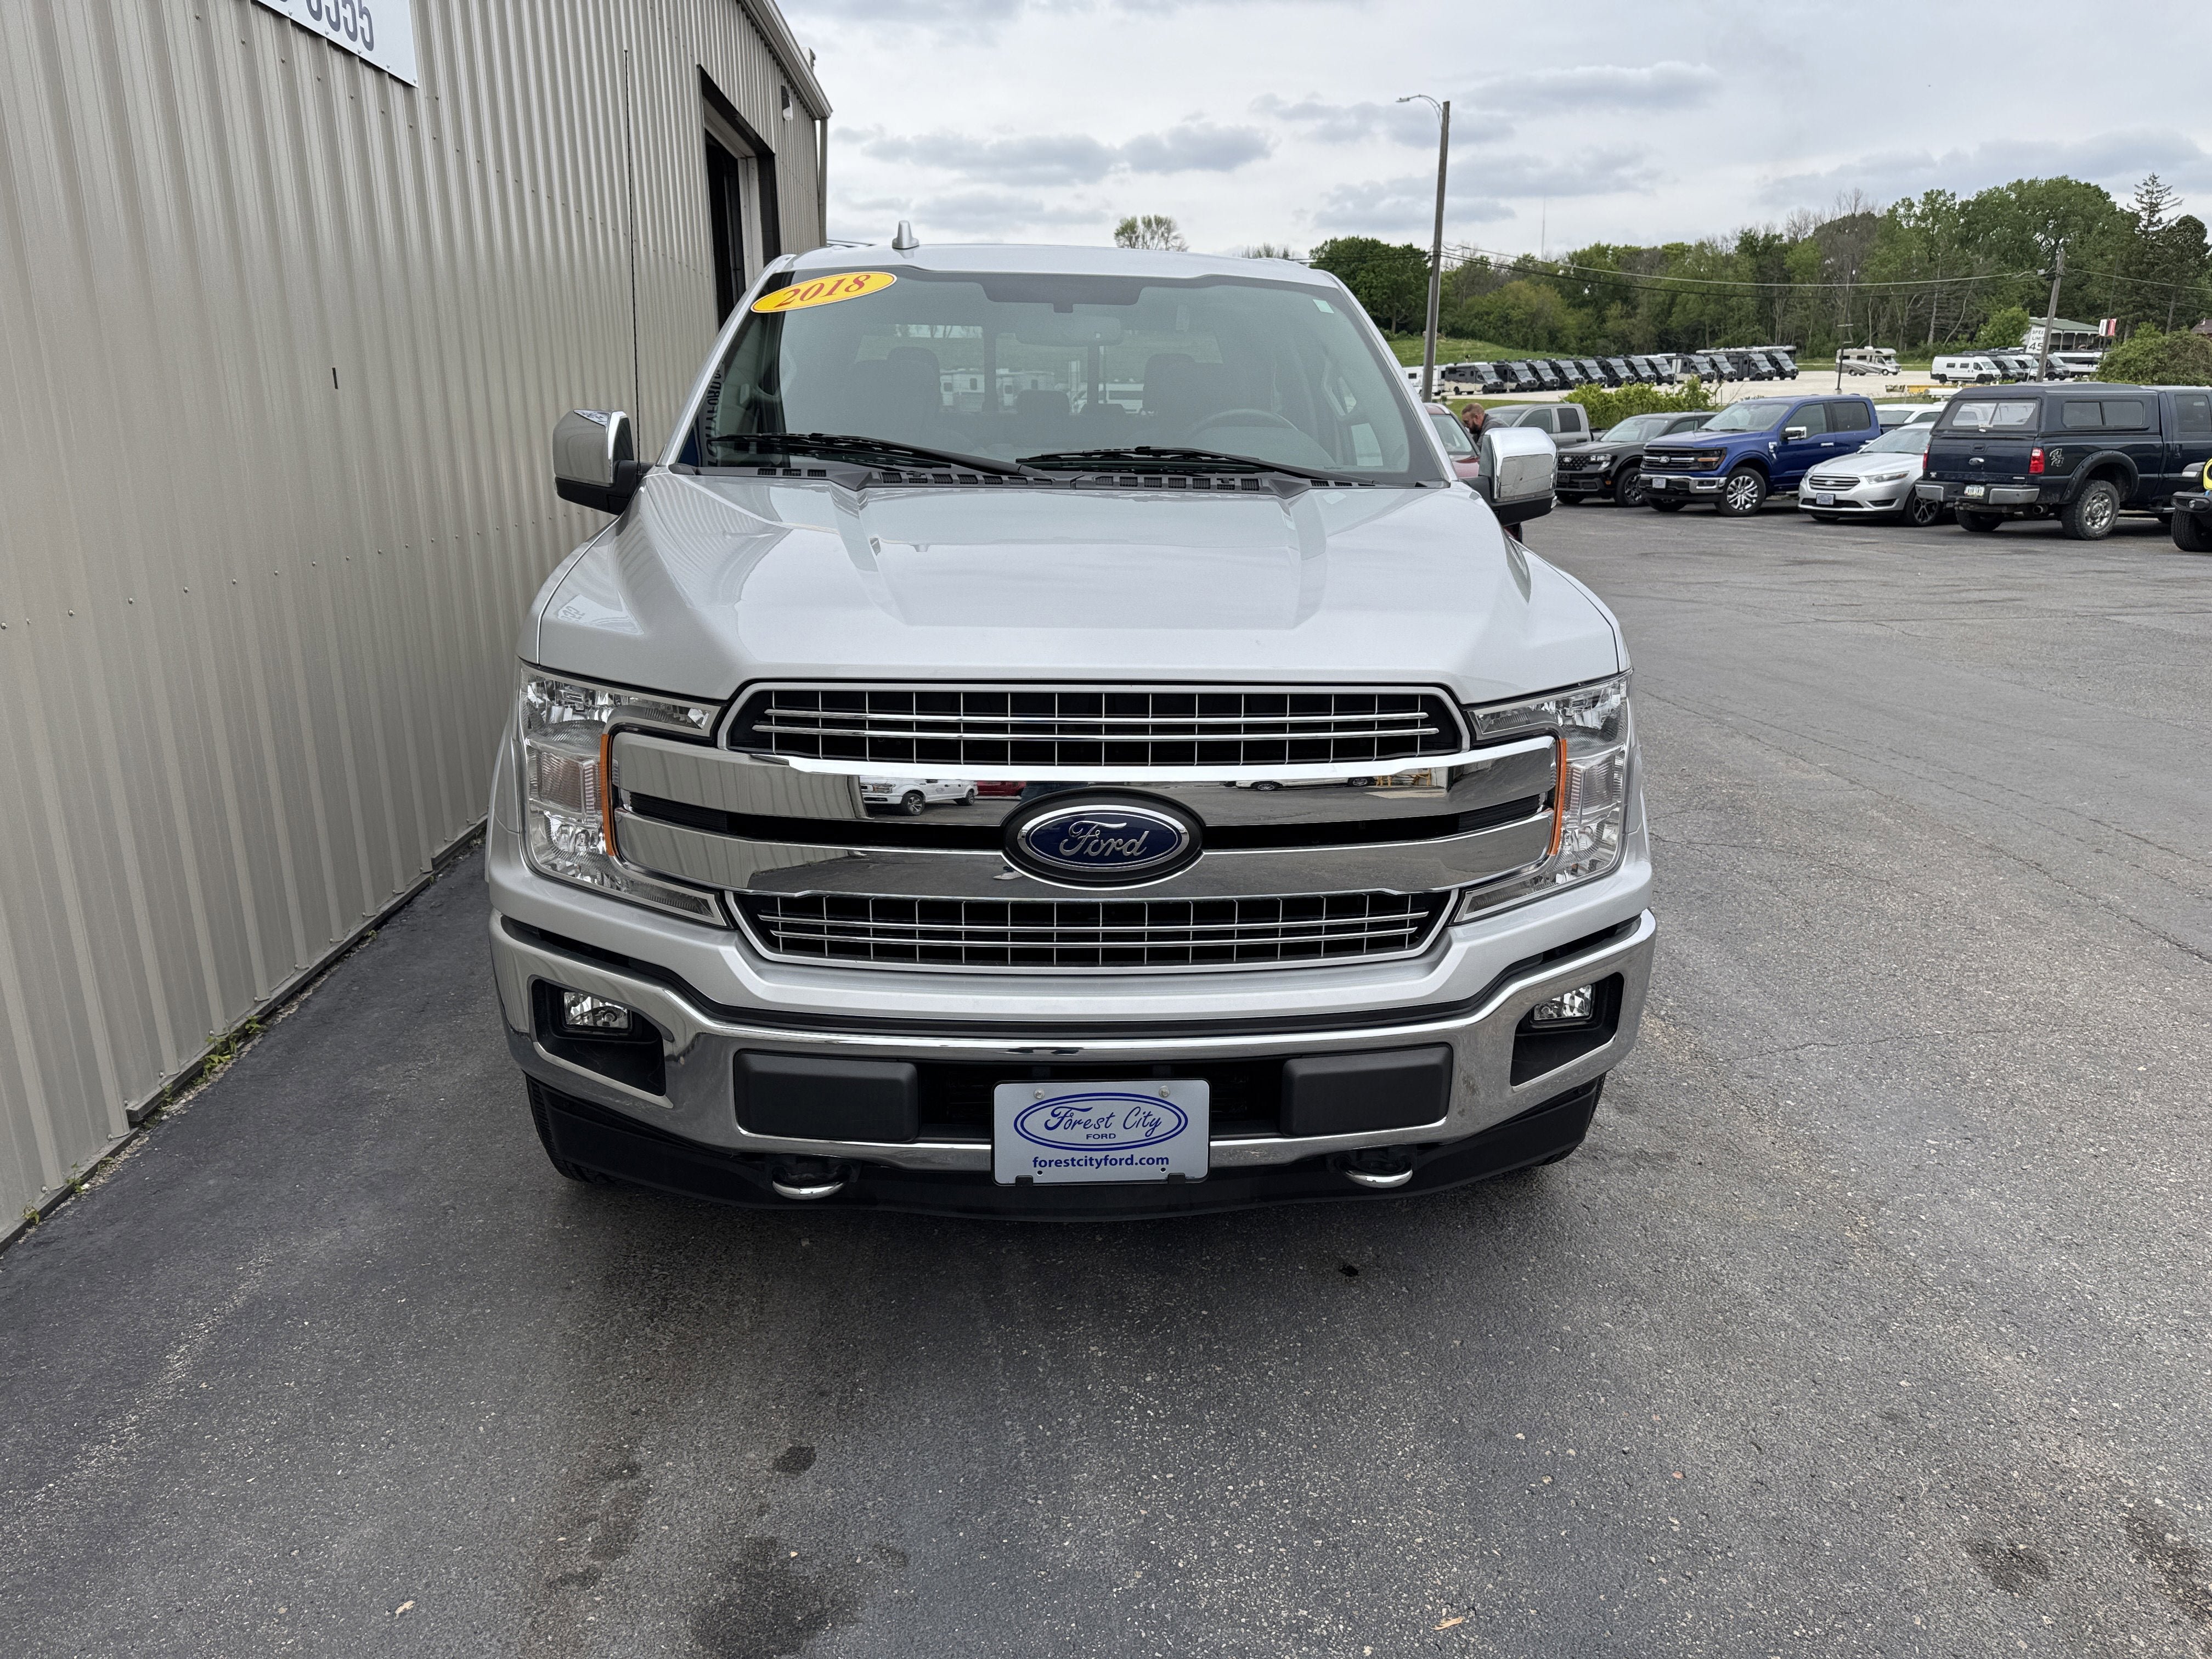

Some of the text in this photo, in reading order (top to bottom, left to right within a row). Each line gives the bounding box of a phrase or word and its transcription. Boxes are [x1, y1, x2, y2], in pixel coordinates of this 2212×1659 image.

[774, 274, 871, 308] 2018
[2029, 342, 2044, 351] 45
[1059, 820, 1150, 856] Ford
[1043, 1105, 1163, 1138] Forest City
[1032, 1154, 1170, 1170] forestcityford.com
